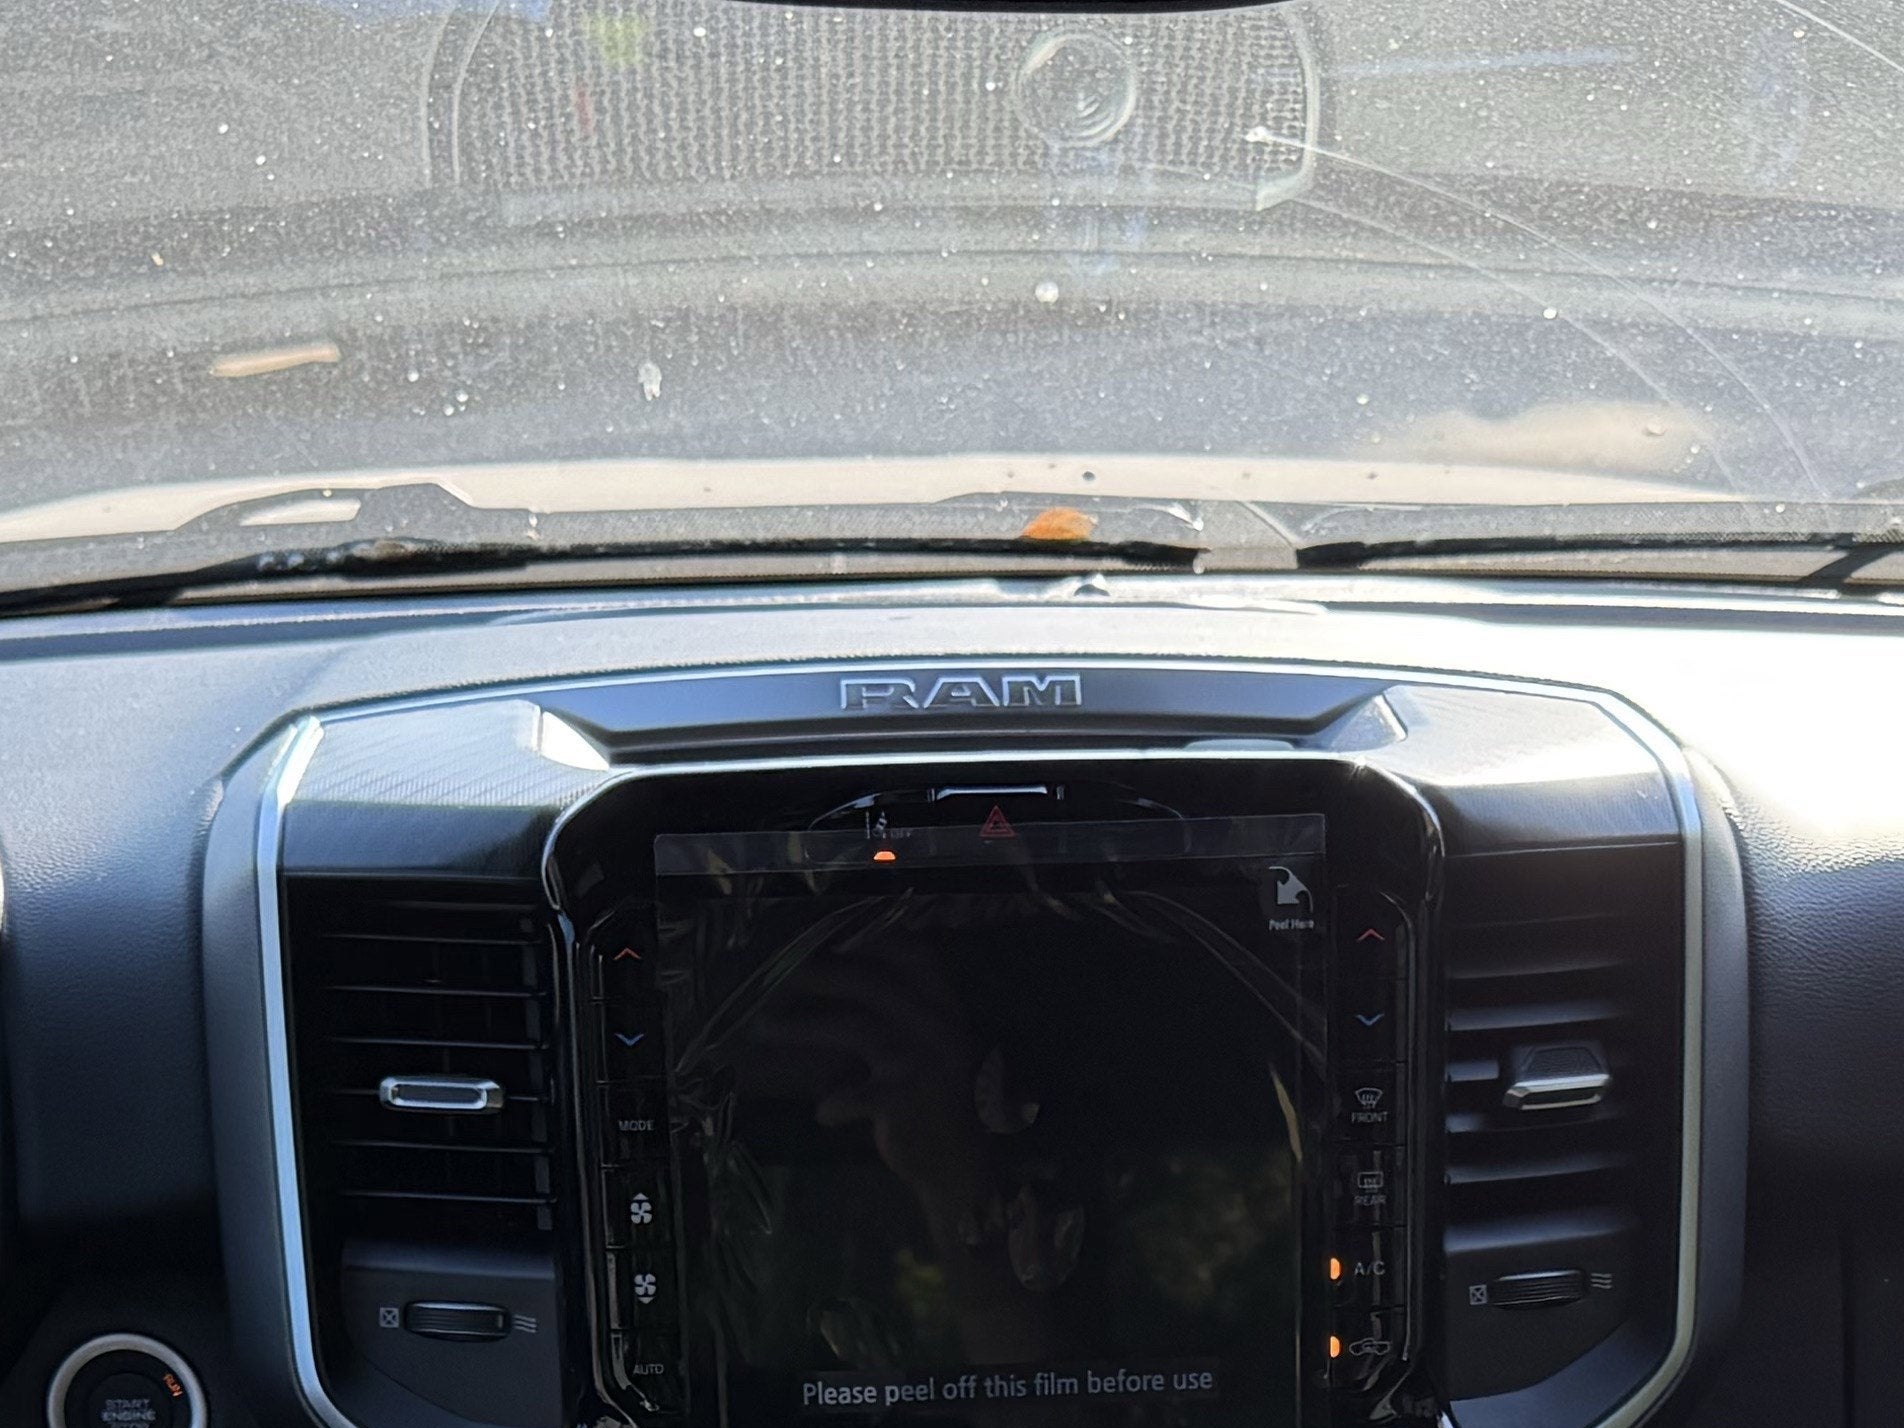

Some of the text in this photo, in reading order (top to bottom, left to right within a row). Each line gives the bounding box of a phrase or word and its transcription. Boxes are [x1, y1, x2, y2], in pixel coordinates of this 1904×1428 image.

[840, 674, 1082, 710] RAM
[1269, 919, 1294, 930] Peel
[1351, 1111, 1387, 1123] FRONT
[619, 1120, 654, 1131] MODE
[1354, 1261, 1386, 1275] A/C
[633, 1364, 664, 1375] AUTO
[162, 1372, 183, 1397] RUN
[803, 1370, 1213, 1407] Please peel off this film before use
[105, 1399, 152, 1409] START
[100, 1409, 156, 1421] ENGINE
